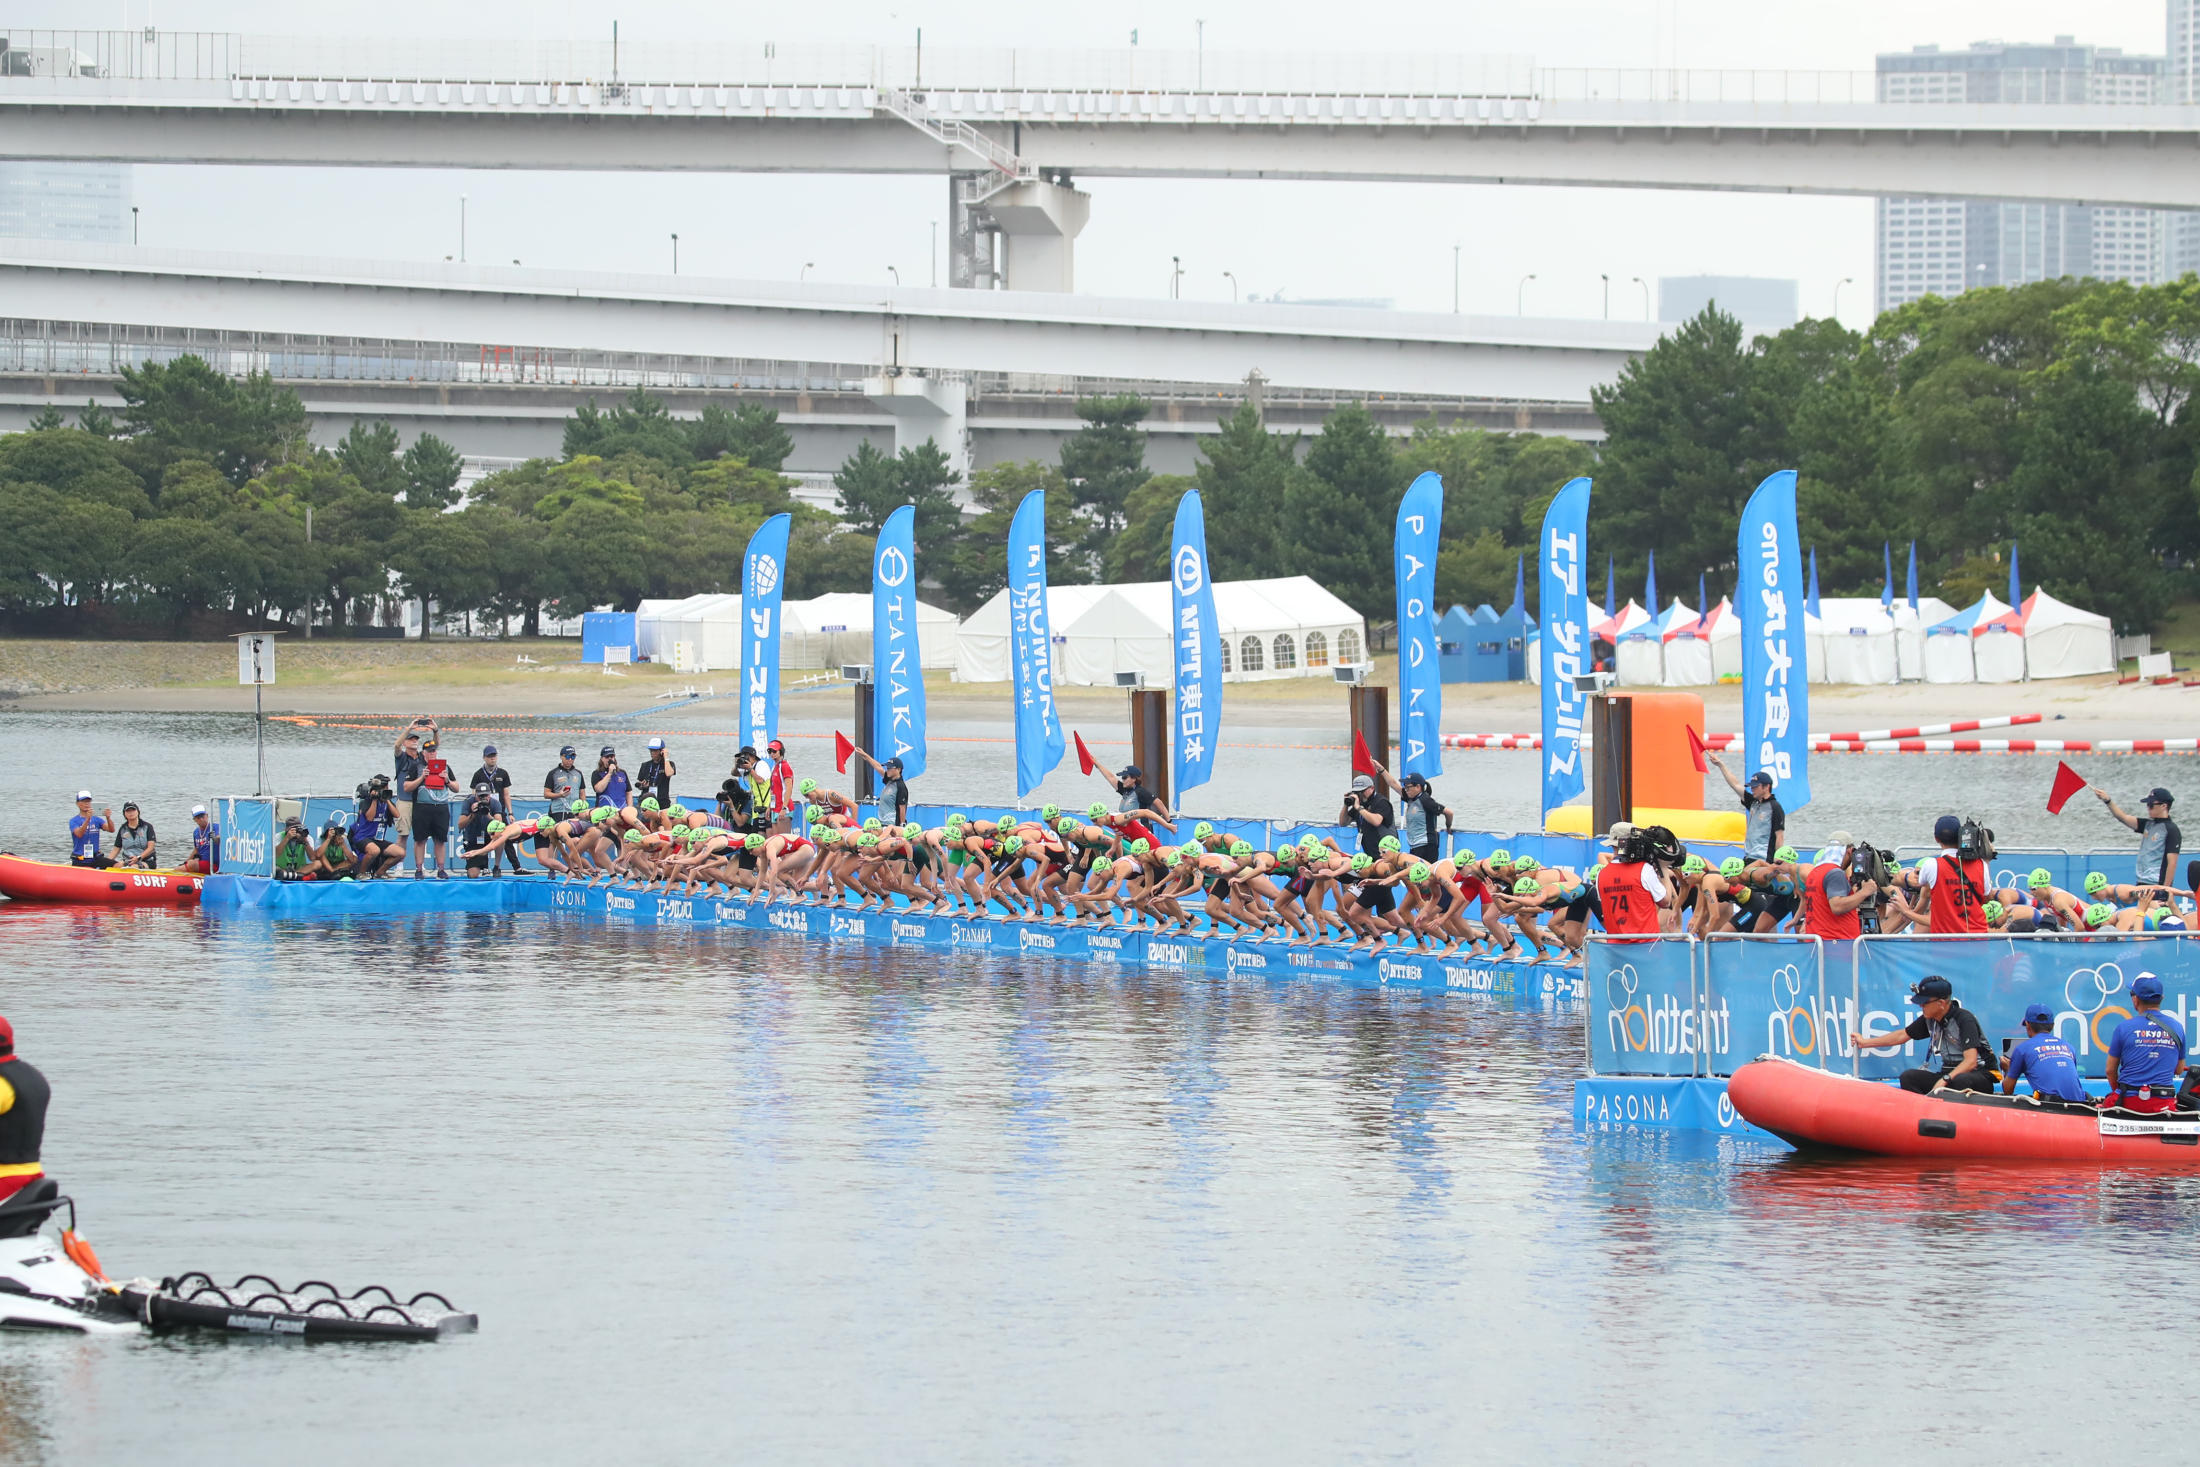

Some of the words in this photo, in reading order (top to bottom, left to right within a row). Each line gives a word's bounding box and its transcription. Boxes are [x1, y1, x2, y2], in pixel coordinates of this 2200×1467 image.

[887, 594, 914, 757] TANAKA
[1180, 604, 1205, 763] NTT東日本
[132, 875, 168, 888] SURF
[551, 890, 586, 907] PASONA
[1610, 895, 1629, 914] 74
[960, 927, 992, 943] TANAKA
[1092, 935, 1122, 949] NOMURA
[1237, 953, 1267, 968] NTT東日本
[1389, 963, 1422, 981] NTT東日本
[1445, 966, 1494, 991] TRIATHLON
[1585, 1094, 1670, 1120] PASONA
